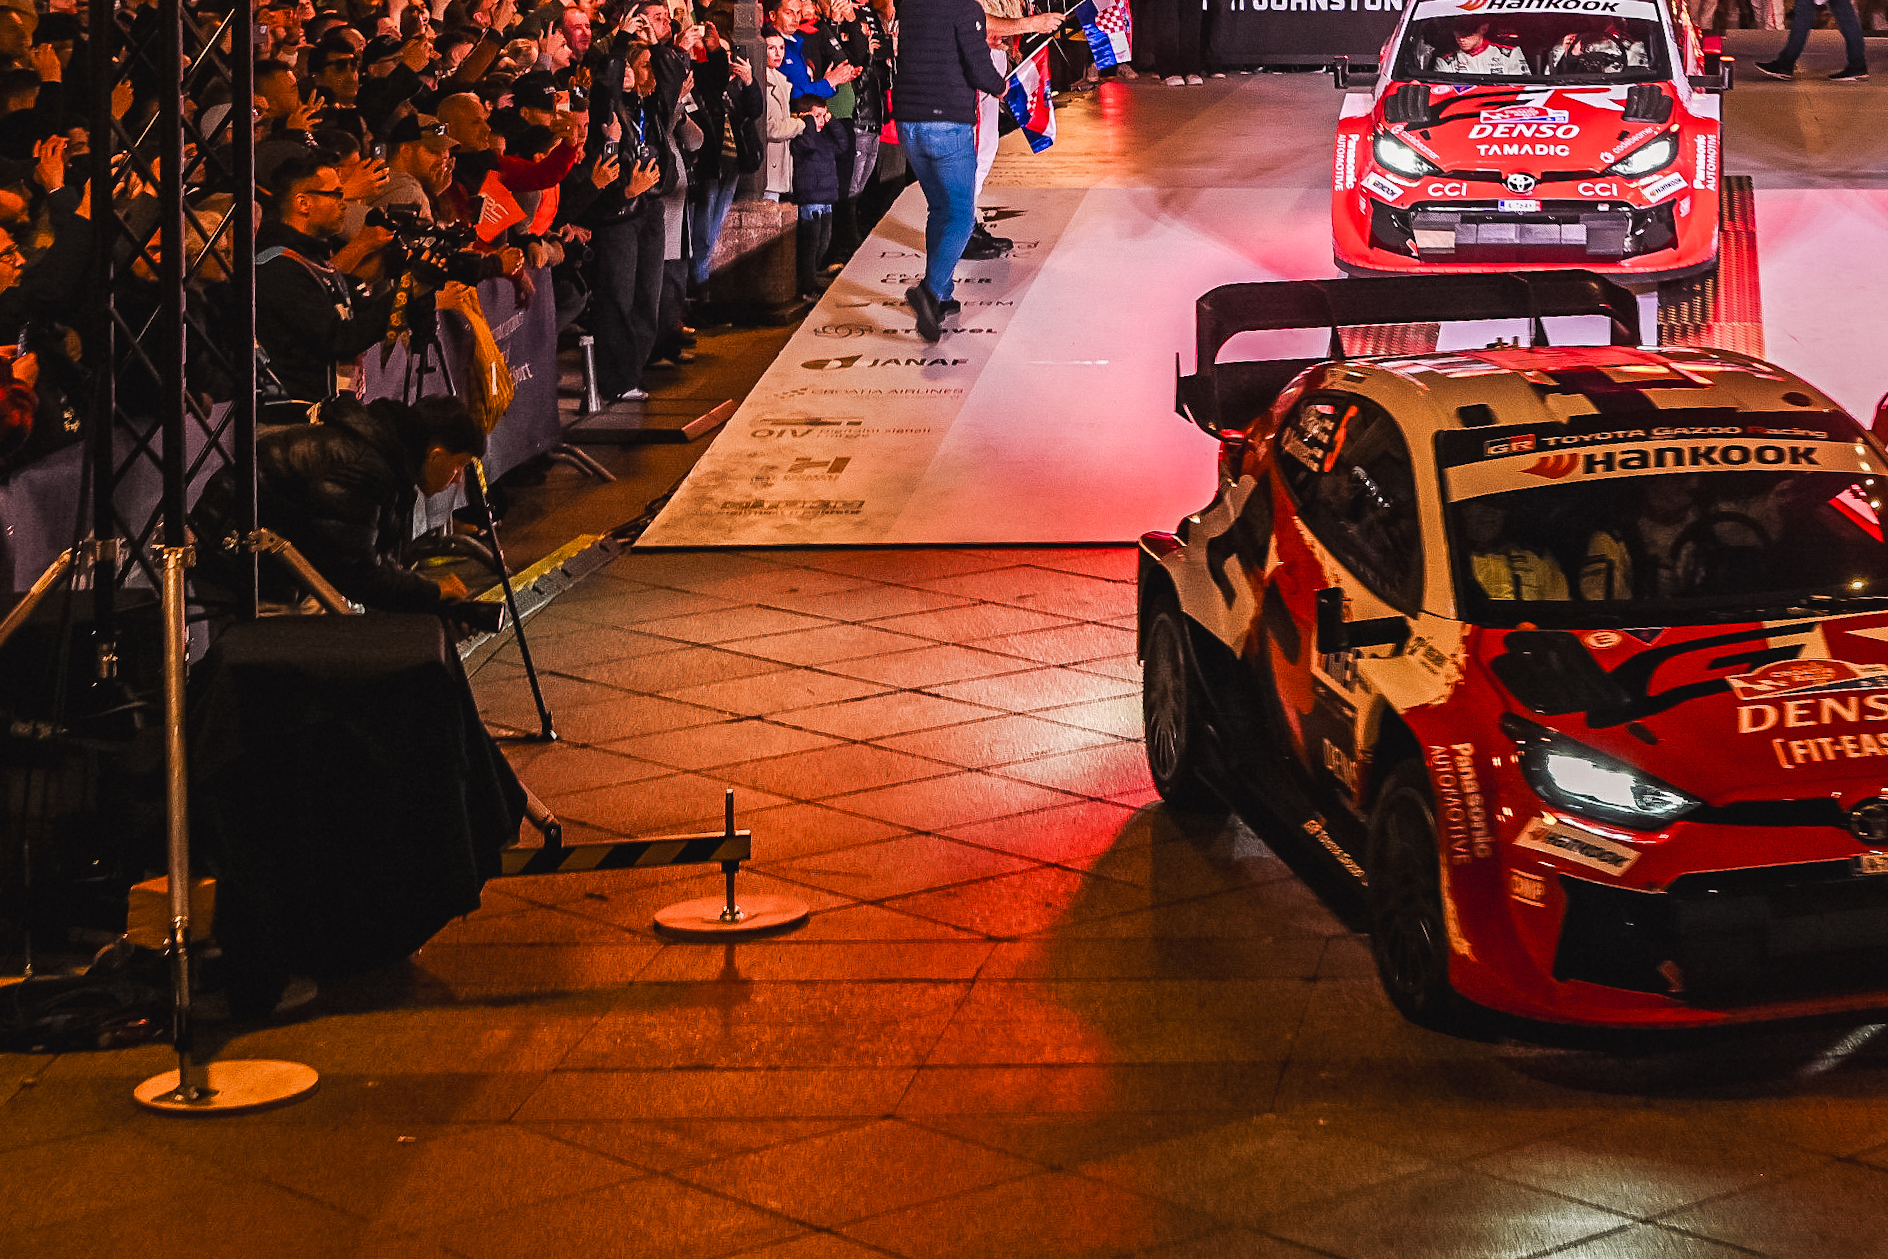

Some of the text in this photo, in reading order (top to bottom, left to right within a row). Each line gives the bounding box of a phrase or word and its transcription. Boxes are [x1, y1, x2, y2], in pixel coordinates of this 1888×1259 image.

[1468, 124, 1580, 139] DENSO
[1477, 145, 1570, 156] TAMADIC
[868, 357, 969, 367] JANAF
[751, 428, 813, 439] OIV
[1542, 428, 1645, 445] TOYOTA
[1649, 426, 1743, 440] GAZOO
[1428, 745, 1473, 865] AUTOMOTIVE
[1451, 742, 1494, 859] Panasonic
